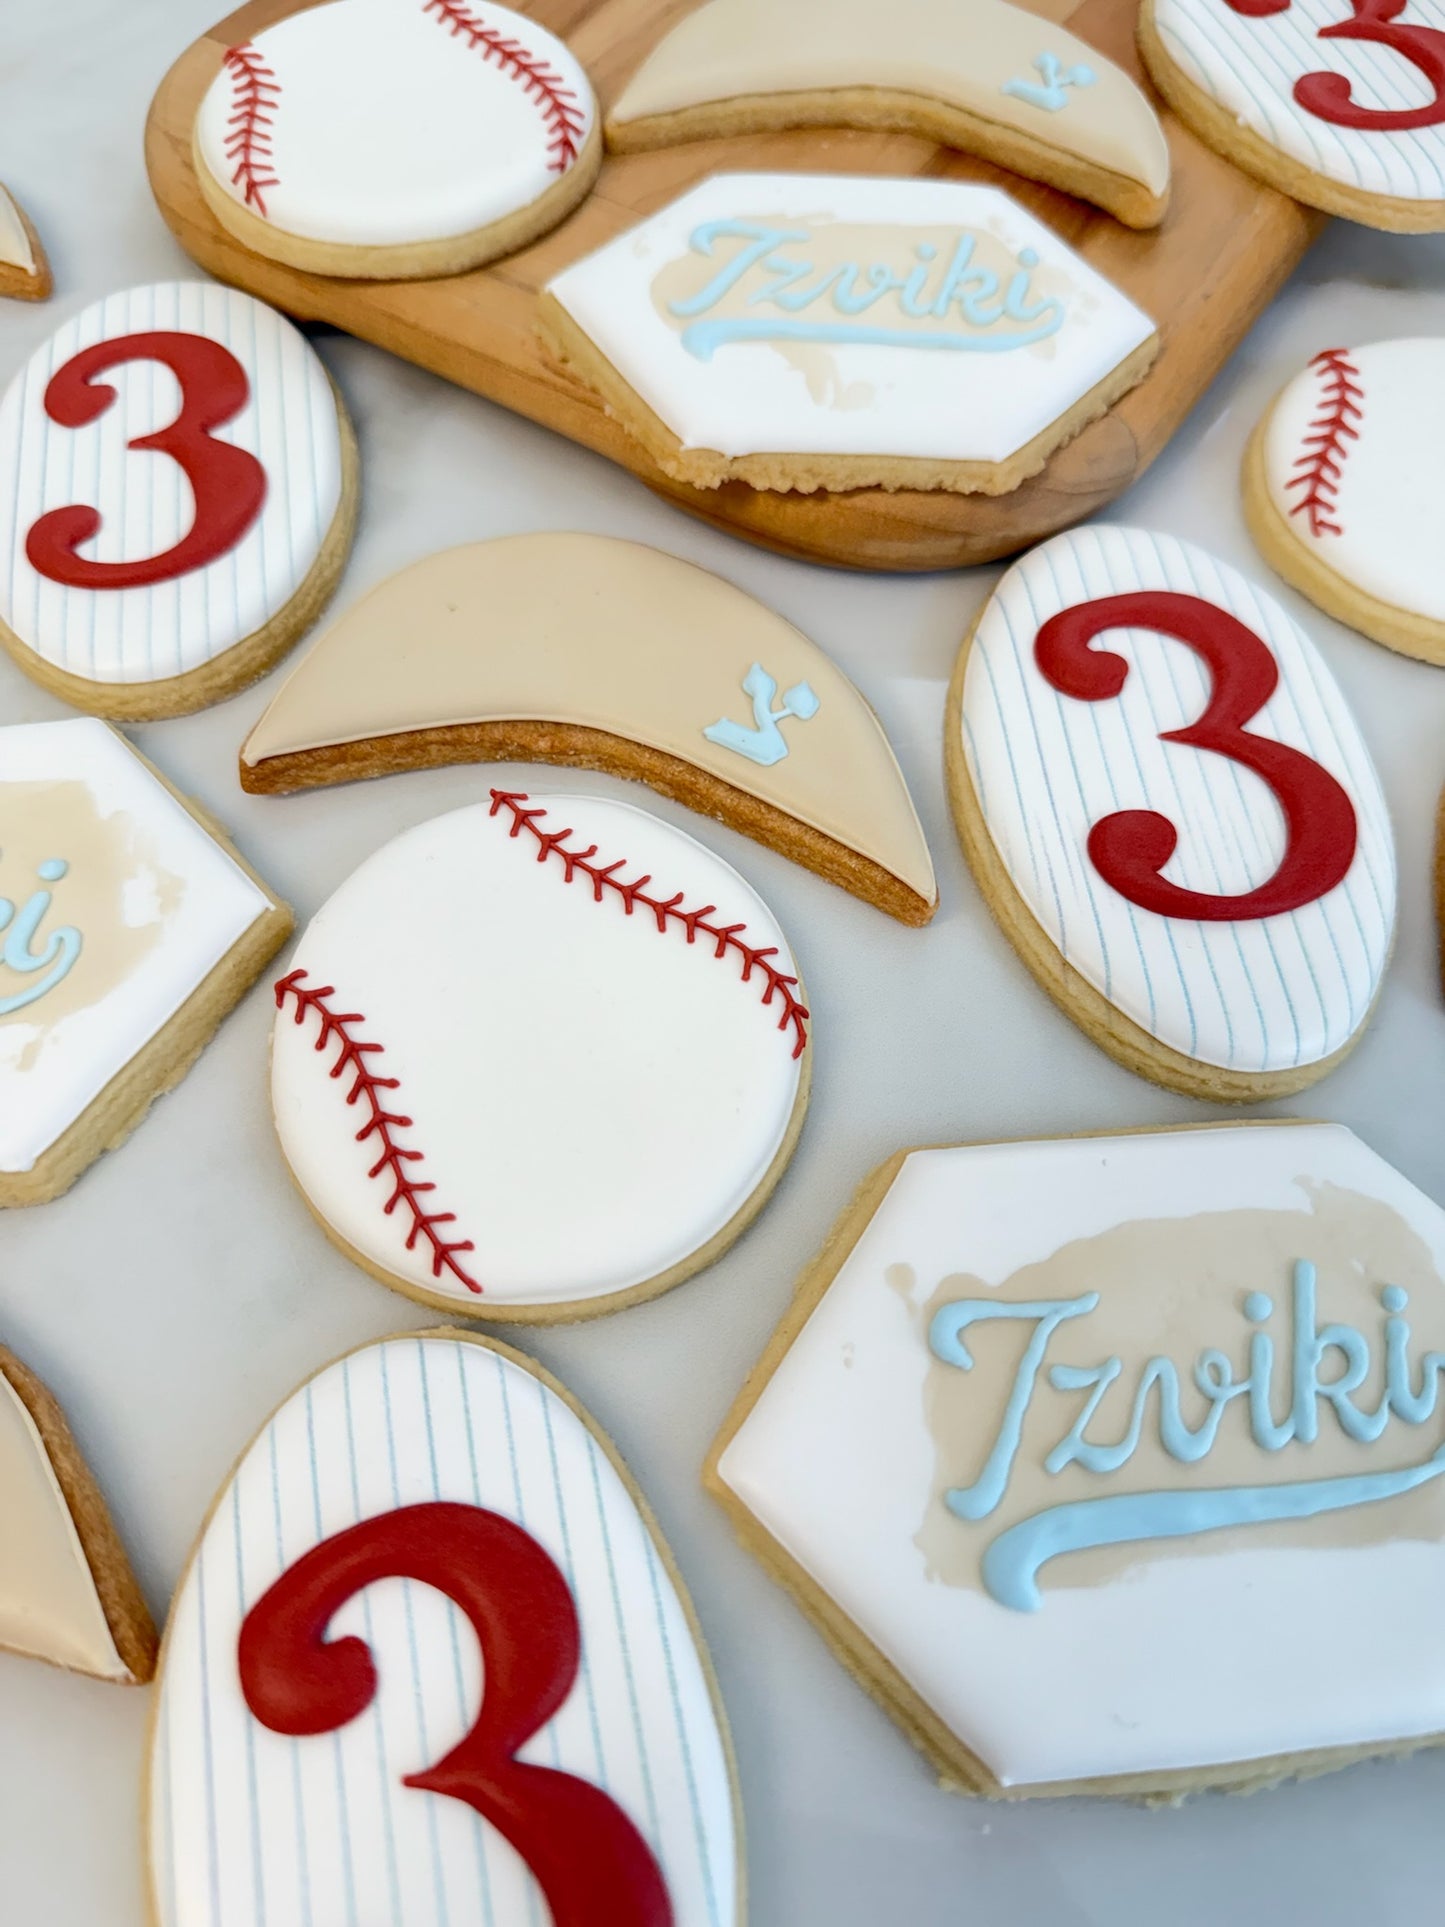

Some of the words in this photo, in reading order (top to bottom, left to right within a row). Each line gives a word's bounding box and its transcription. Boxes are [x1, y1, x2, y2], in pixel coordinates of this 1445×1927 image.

[1224, 0, 1445, 131] 3
[668, 219, 1065, 336] Tzviki
[26, 331, 268, 590] 3
[1034, 591, 1357, 922] 3
[929, 1258, 1445, 1521] Tzviki
[237, 1501, 674, 1927] 3
